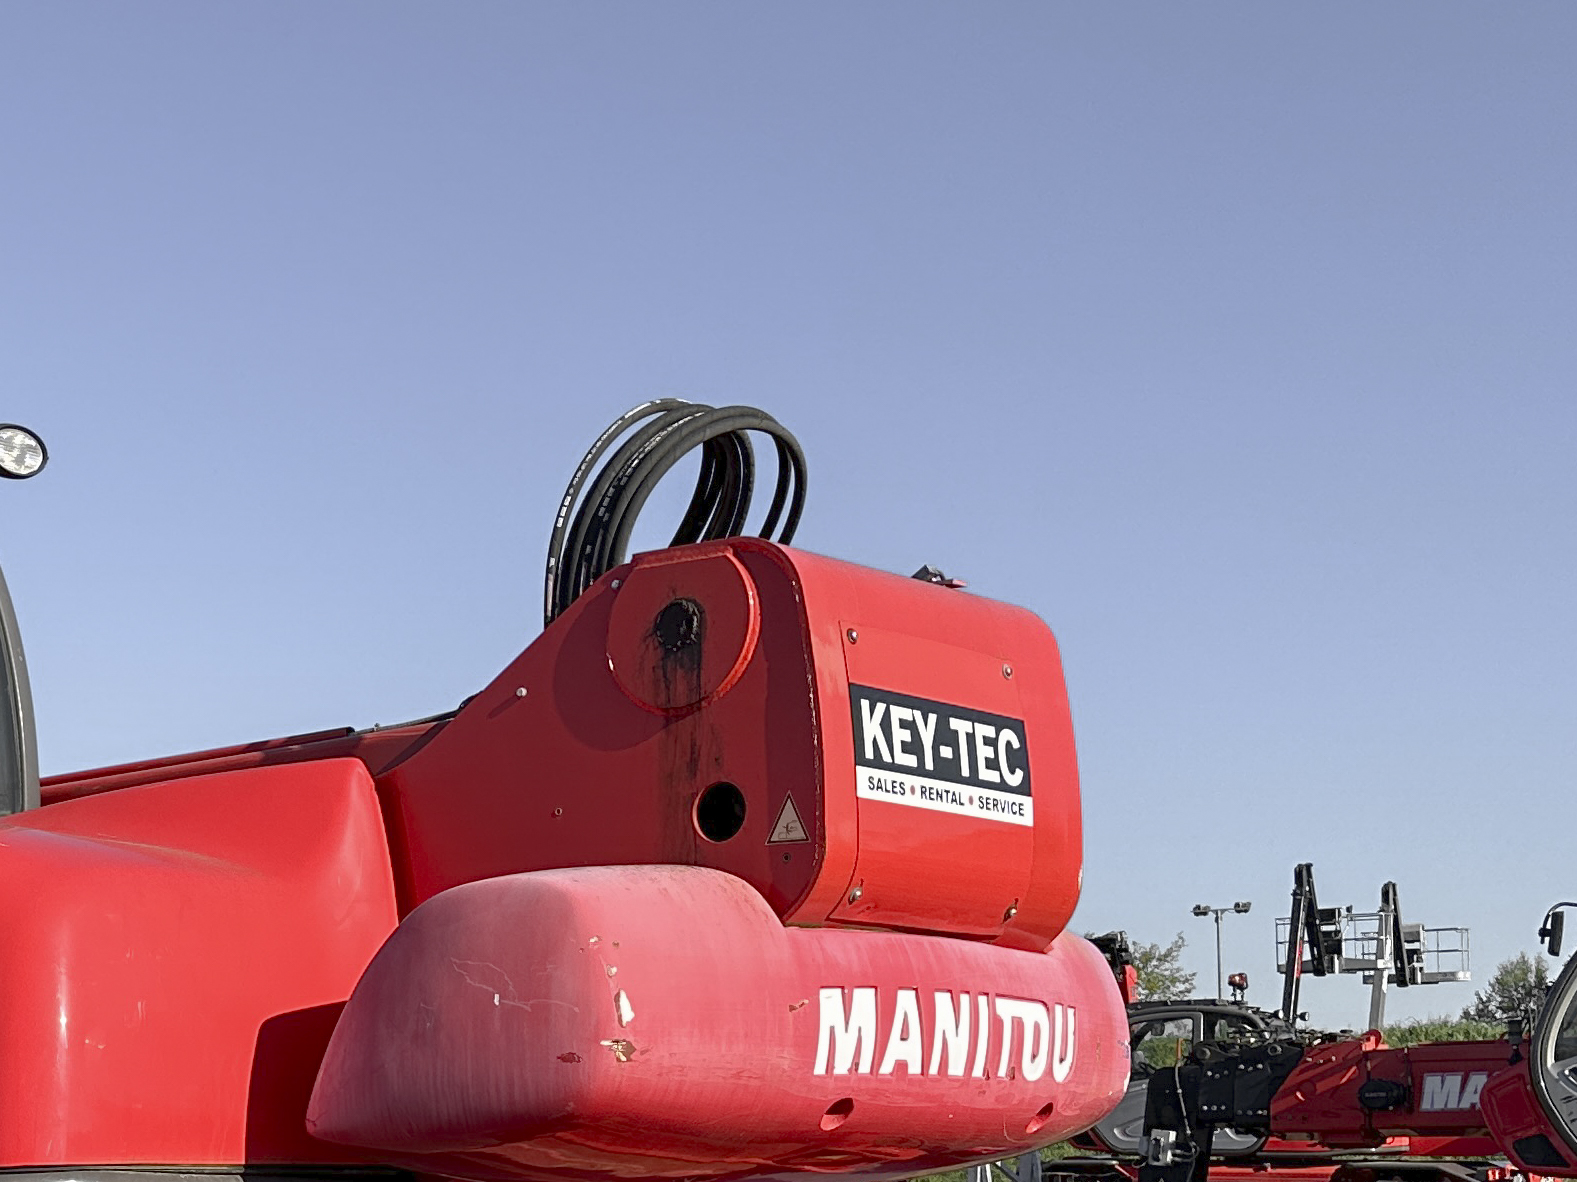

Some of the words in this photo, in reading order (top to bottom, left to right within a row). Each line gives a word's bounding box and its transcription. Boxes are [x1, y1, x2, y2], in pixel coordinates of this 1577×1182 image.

[860, 698, 1024, 787] KEY-TEC
[867, 775, 906, 796] SALES
[920, 785, 965, 806] RENTAL
[978, 796, 1025, 817] SERVICE
[813, 985, 1076, 1084] MANITOU
